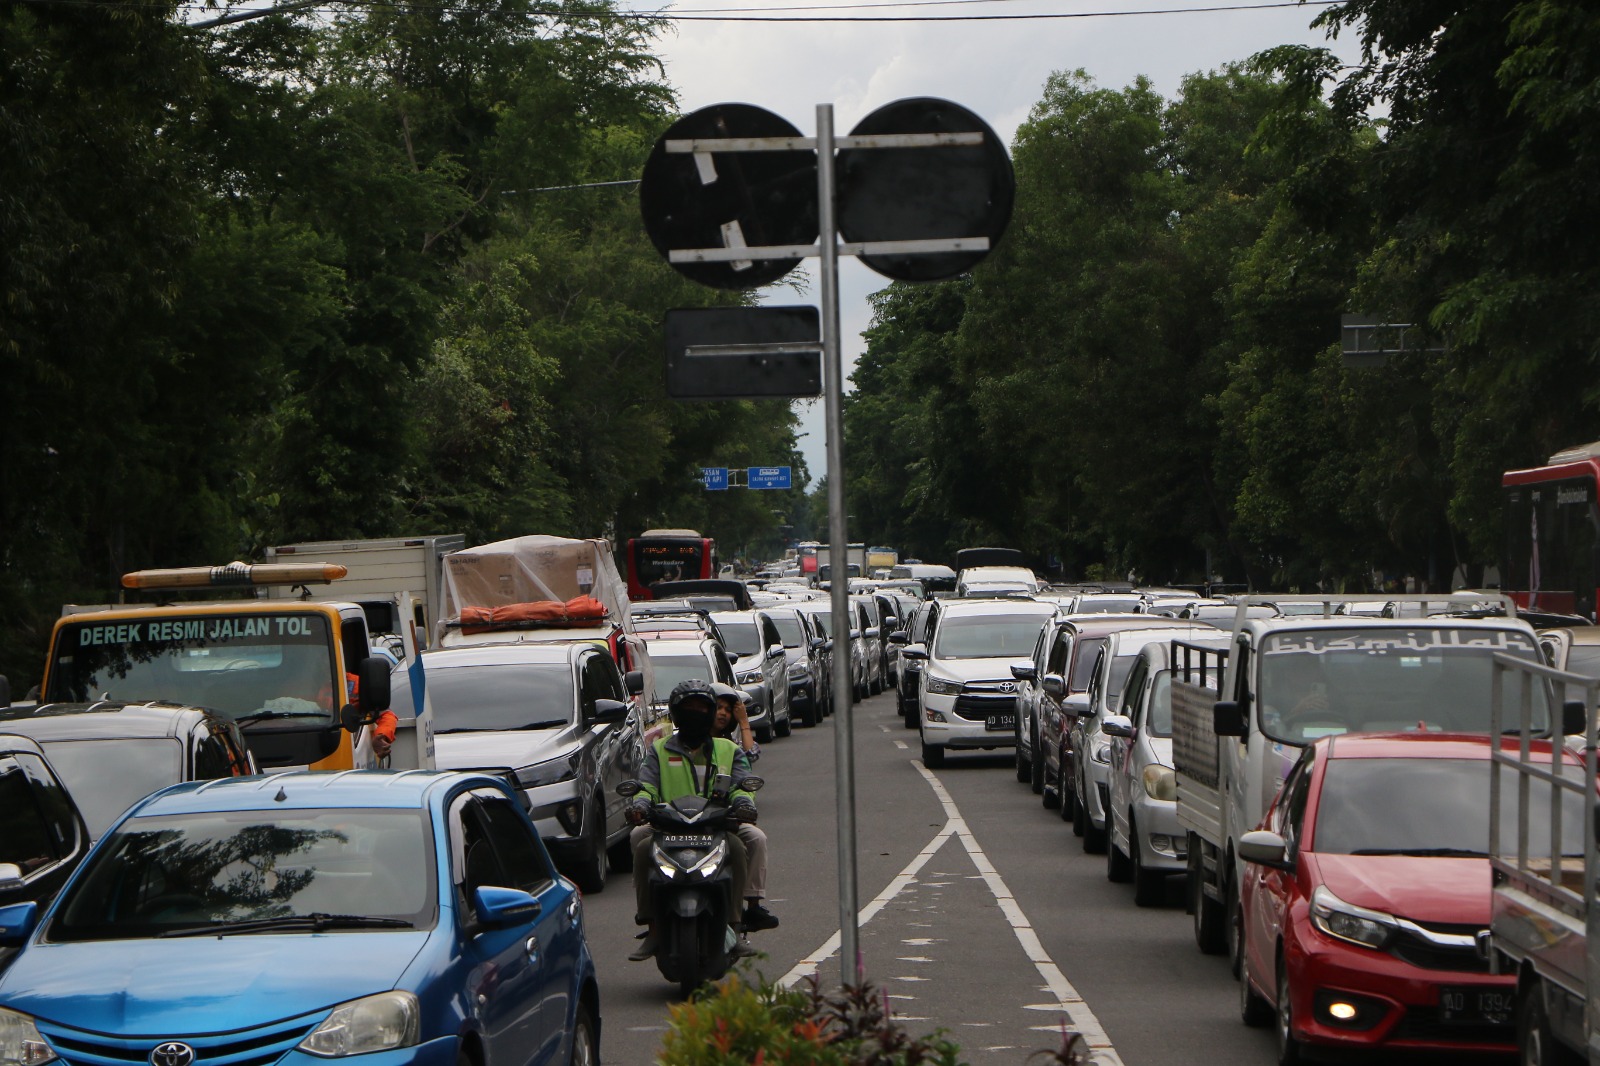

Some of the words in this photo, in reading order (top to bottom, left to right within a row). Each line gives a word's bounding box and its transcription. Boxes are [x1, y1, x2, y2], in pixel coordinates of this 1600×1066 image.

[80, 624, 141, 646] DEREK
[148, 620, 204, 641] RESMI
[209, 618, 270, 638] JALAN
[275, 617, 312, 635] TOL
